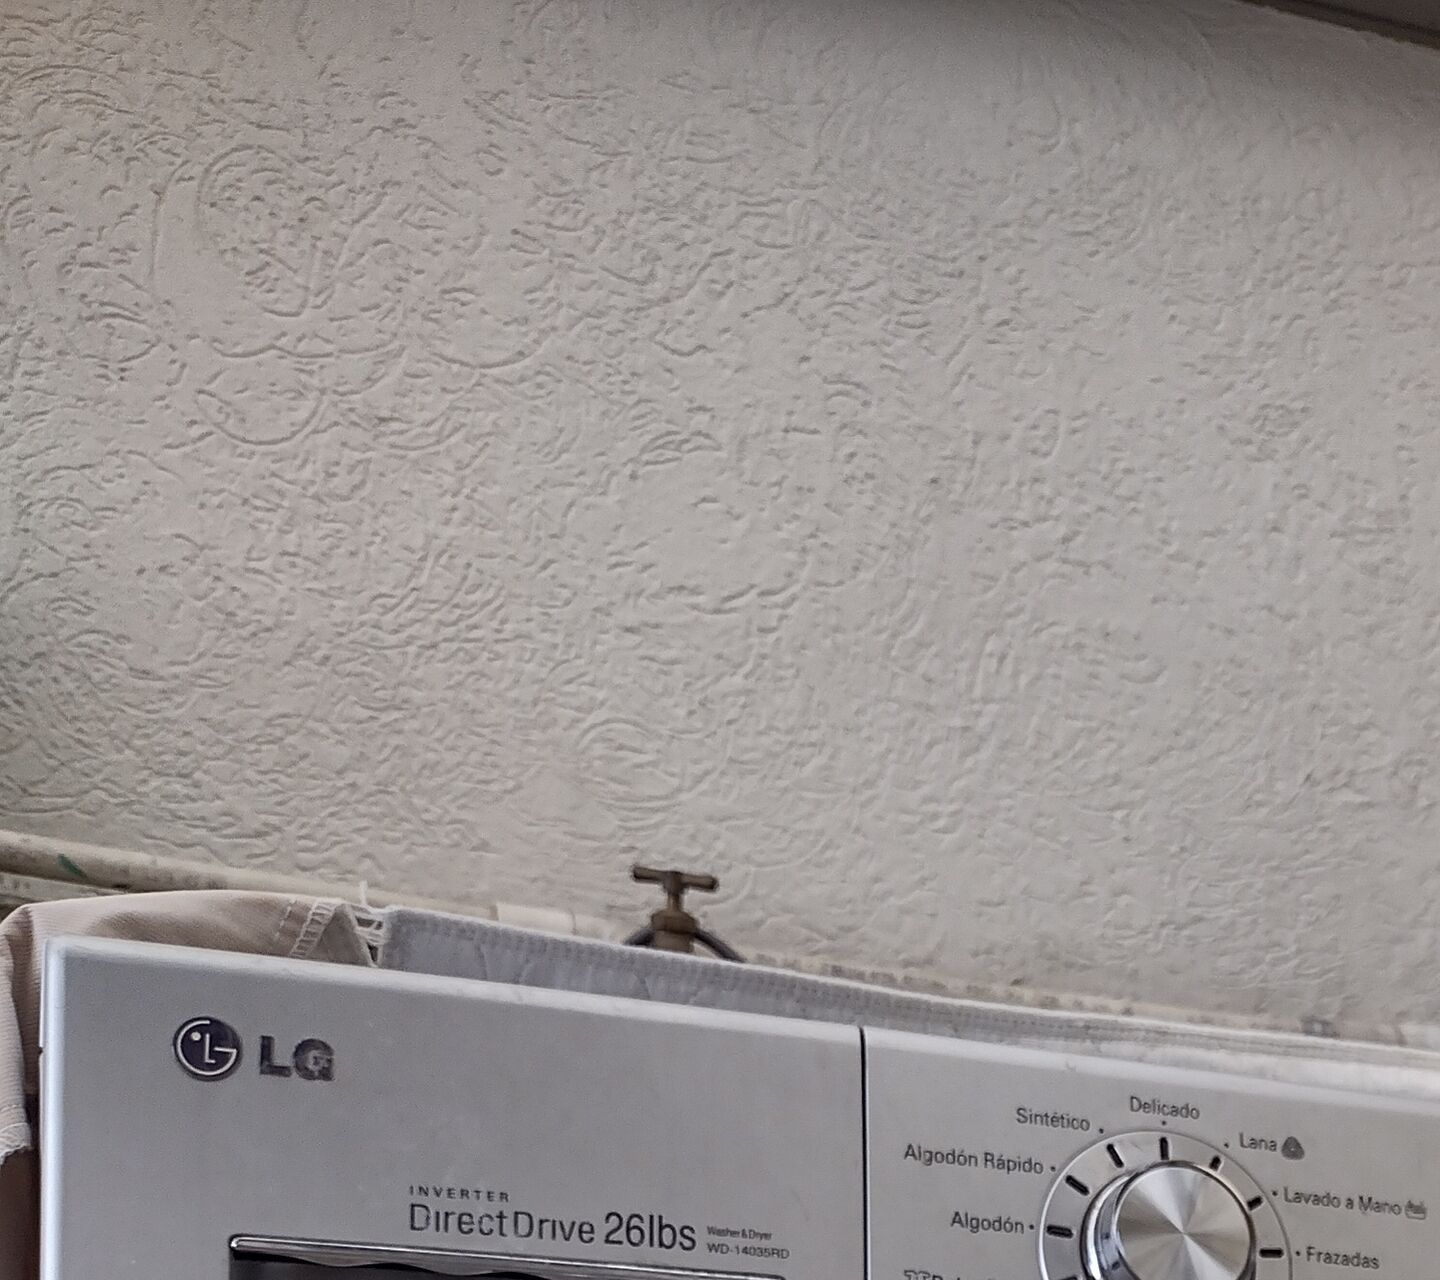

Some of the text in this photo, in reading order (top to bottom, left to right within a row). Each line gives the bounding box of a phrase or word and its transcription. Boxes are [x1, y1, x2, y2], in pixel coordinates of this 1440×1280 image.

[260, 1035, 335, 1082] LG
[1016, 1107, 1091, 1132] Sintético
[1130, 1096, 1201, 1120] Delicado
[1239, 1132, 1278, 1152] Lana
[904, 1143, 1044, 1174] Algodón Rápido
[409, 1185, 510, 1203] INVERTER
[1283, 1186, 1401, 1216] Lavado a Mano
[604, 1211, 697, 1251] 26lbs
[950, 1211, 1024, 1234] Algodón
[1306, 1246, 1380, 1269] Frazadas
